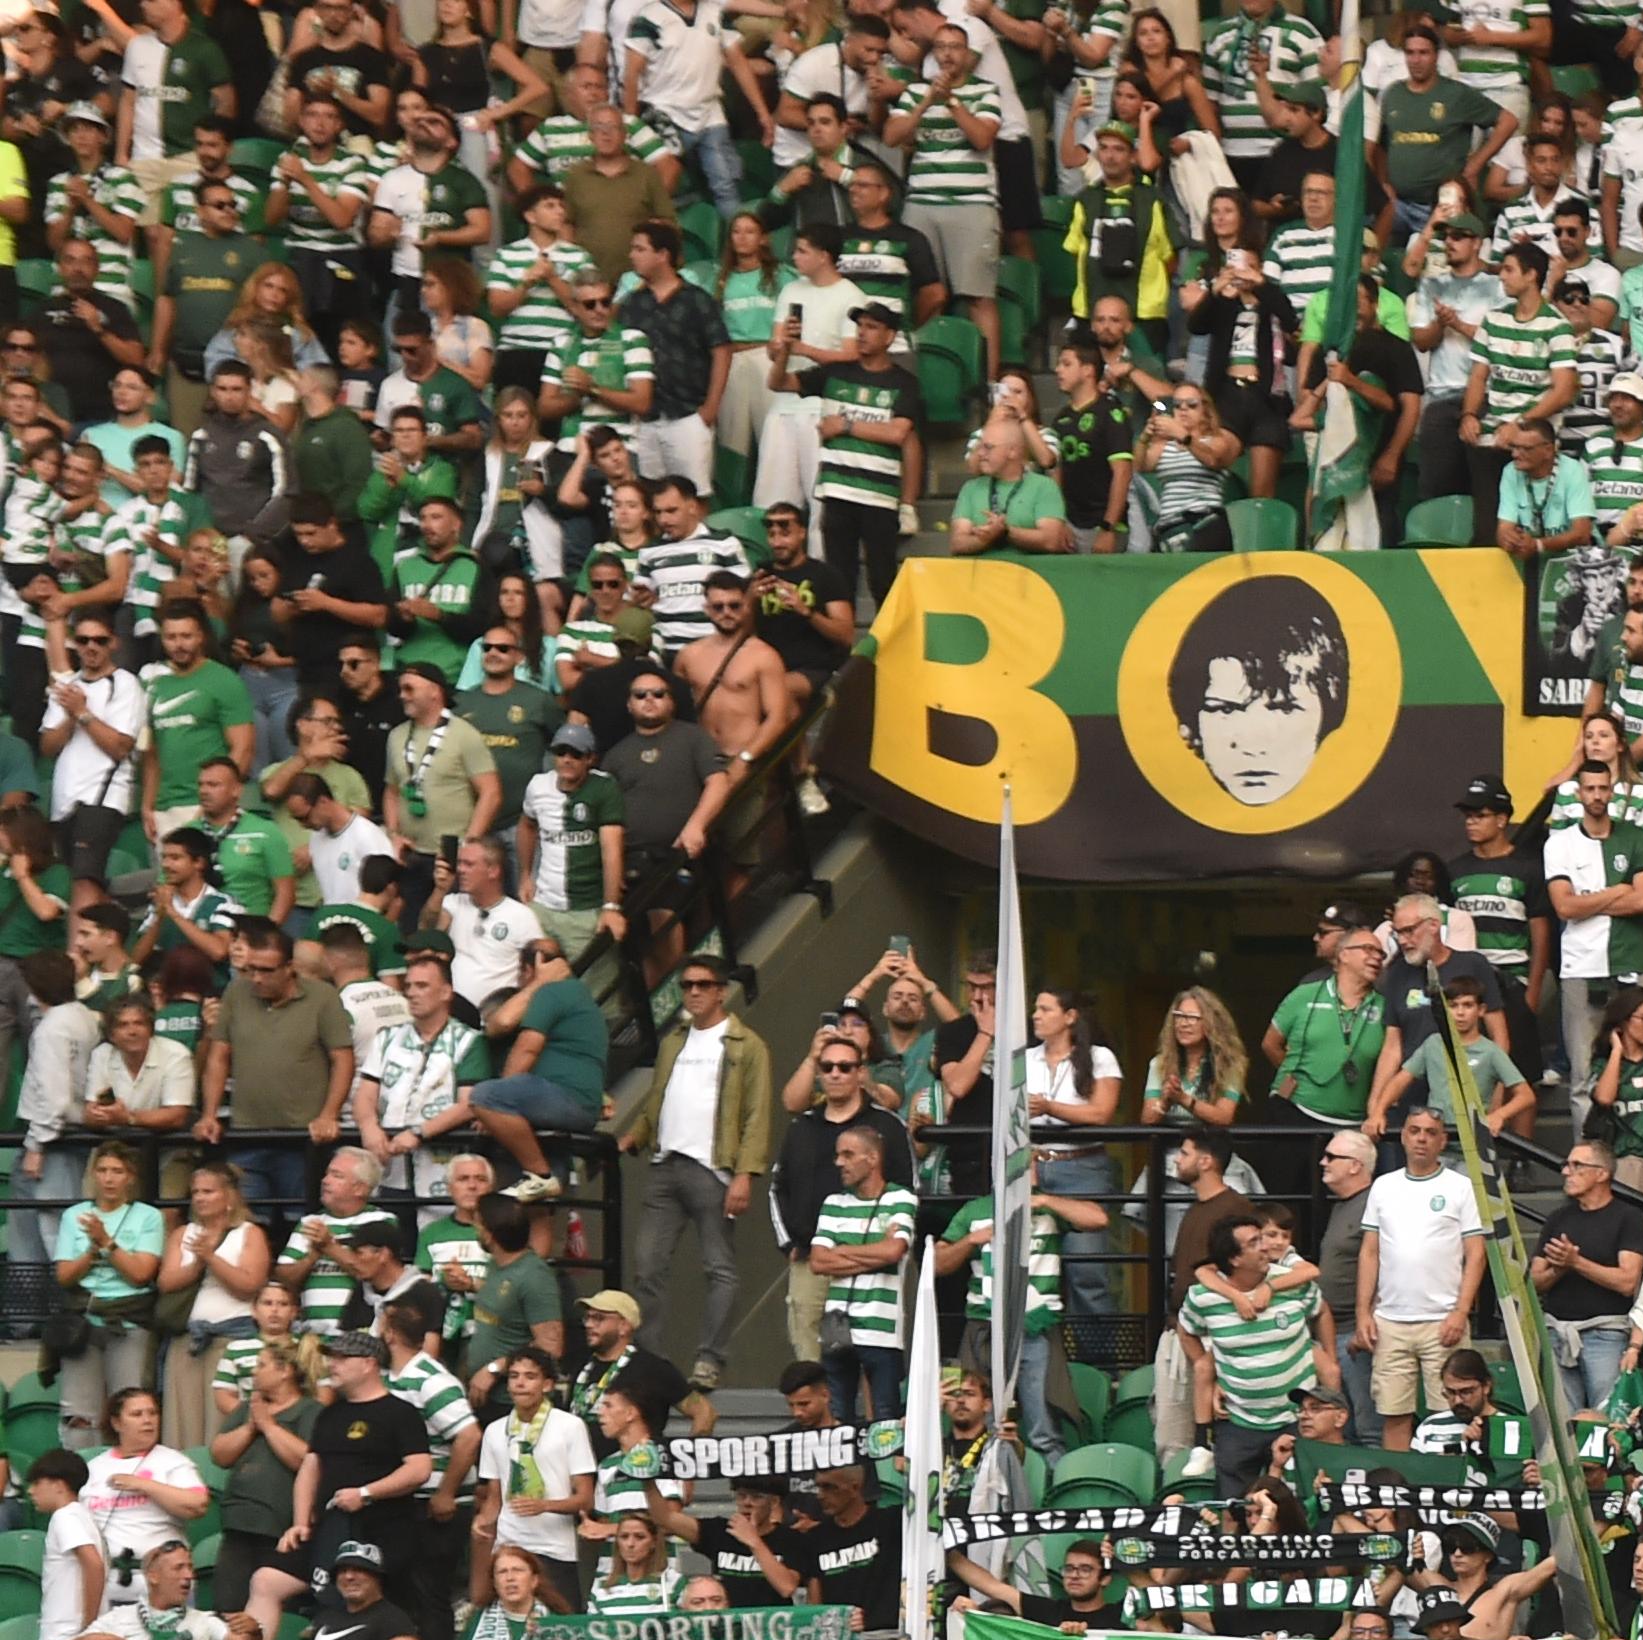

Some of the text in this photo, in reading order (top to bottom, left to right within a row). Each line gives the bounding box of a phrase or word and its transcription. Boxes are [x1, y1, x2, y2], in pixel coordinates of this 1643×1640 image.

[670, 582, 705, 599] Betan
[673, 1425, 858, 1480] SPORTING
[1340, 1484, 1548, 1510] BRIGAD
[942, 1505, 1182, 1550] BRIGADA
[1177, 1534, 1335, 1550] SPORTING
[1178, 1549, 1334, 1562] FORÇA BRUTAL
[1147, 1577, 1377, 1609] BRIGADA
